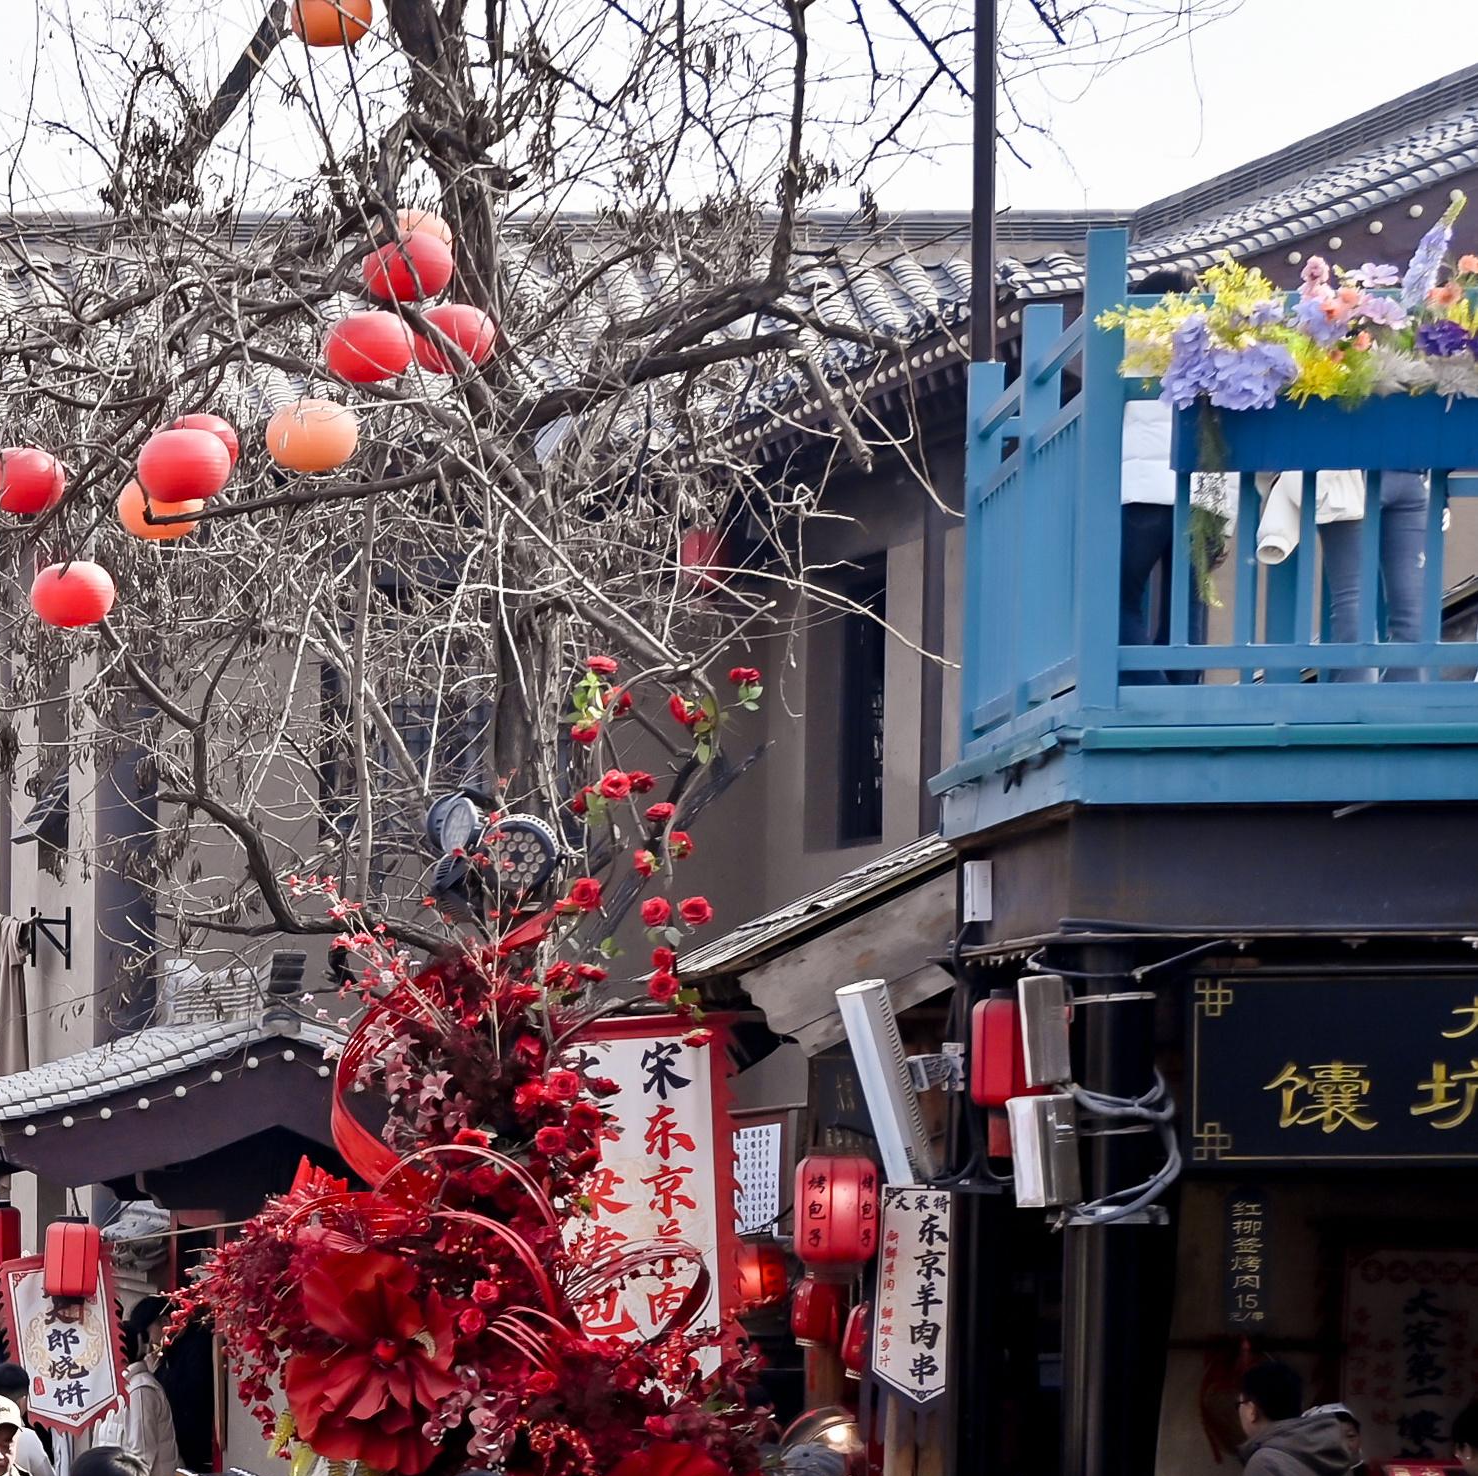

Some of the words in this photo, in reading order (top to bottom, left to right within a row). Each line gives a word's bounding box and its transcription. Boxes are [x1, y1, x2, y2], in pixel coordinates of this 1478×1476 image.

[808, 1173, 827, 1248] 烤包子
[908, 1213, 949, 1386] 东京羊肉串
[1235, 1294, 1259, 1309] 15
